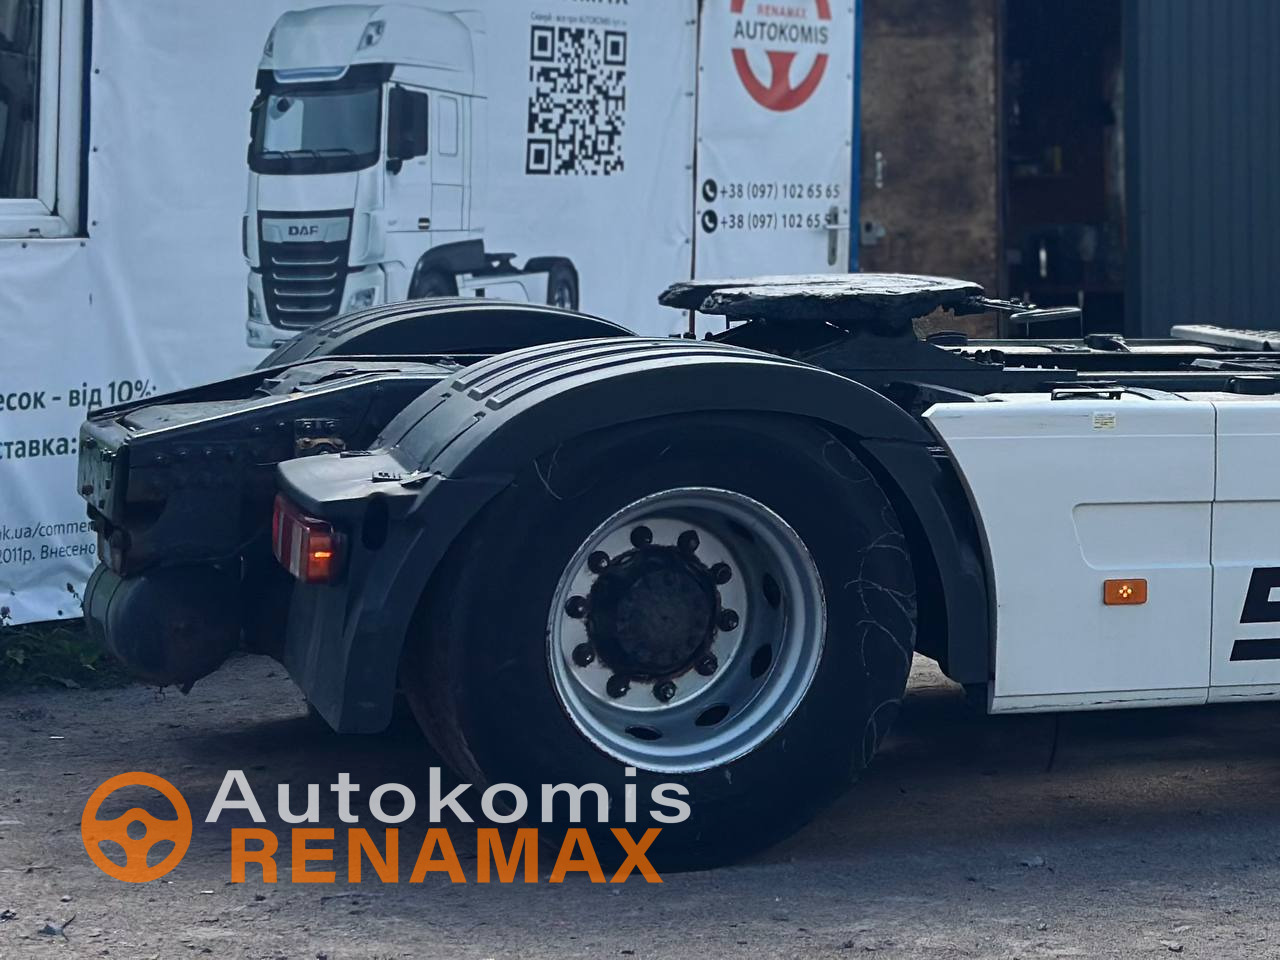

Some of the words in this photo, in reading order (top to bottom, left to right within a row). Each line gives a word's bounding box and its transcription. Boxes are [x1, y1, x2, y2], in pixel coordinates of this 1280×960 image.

[757, 3, 806, 18] RENAMAX
[734, 21, 829, 45] AUTOKOMIS
[720, 183, 743, 199] +38
[747, 182, 778, 200] (097)
[782, 183, 804, 199] 102
[807, 183, 822, 199] 65
[825, 184, 840, 199] 65
[720, 213, 744, 229] +38
[748, 212, 778, 230] (097)
[782, 214, 803, 228] 102
[806, 214, 821, 229] 65
[288, 225, 319, 236] DAF
[69, 382, 103, 410] від
[0, 436, 77, 460] тавка:
[41, 542, 96, 559] Внесено
